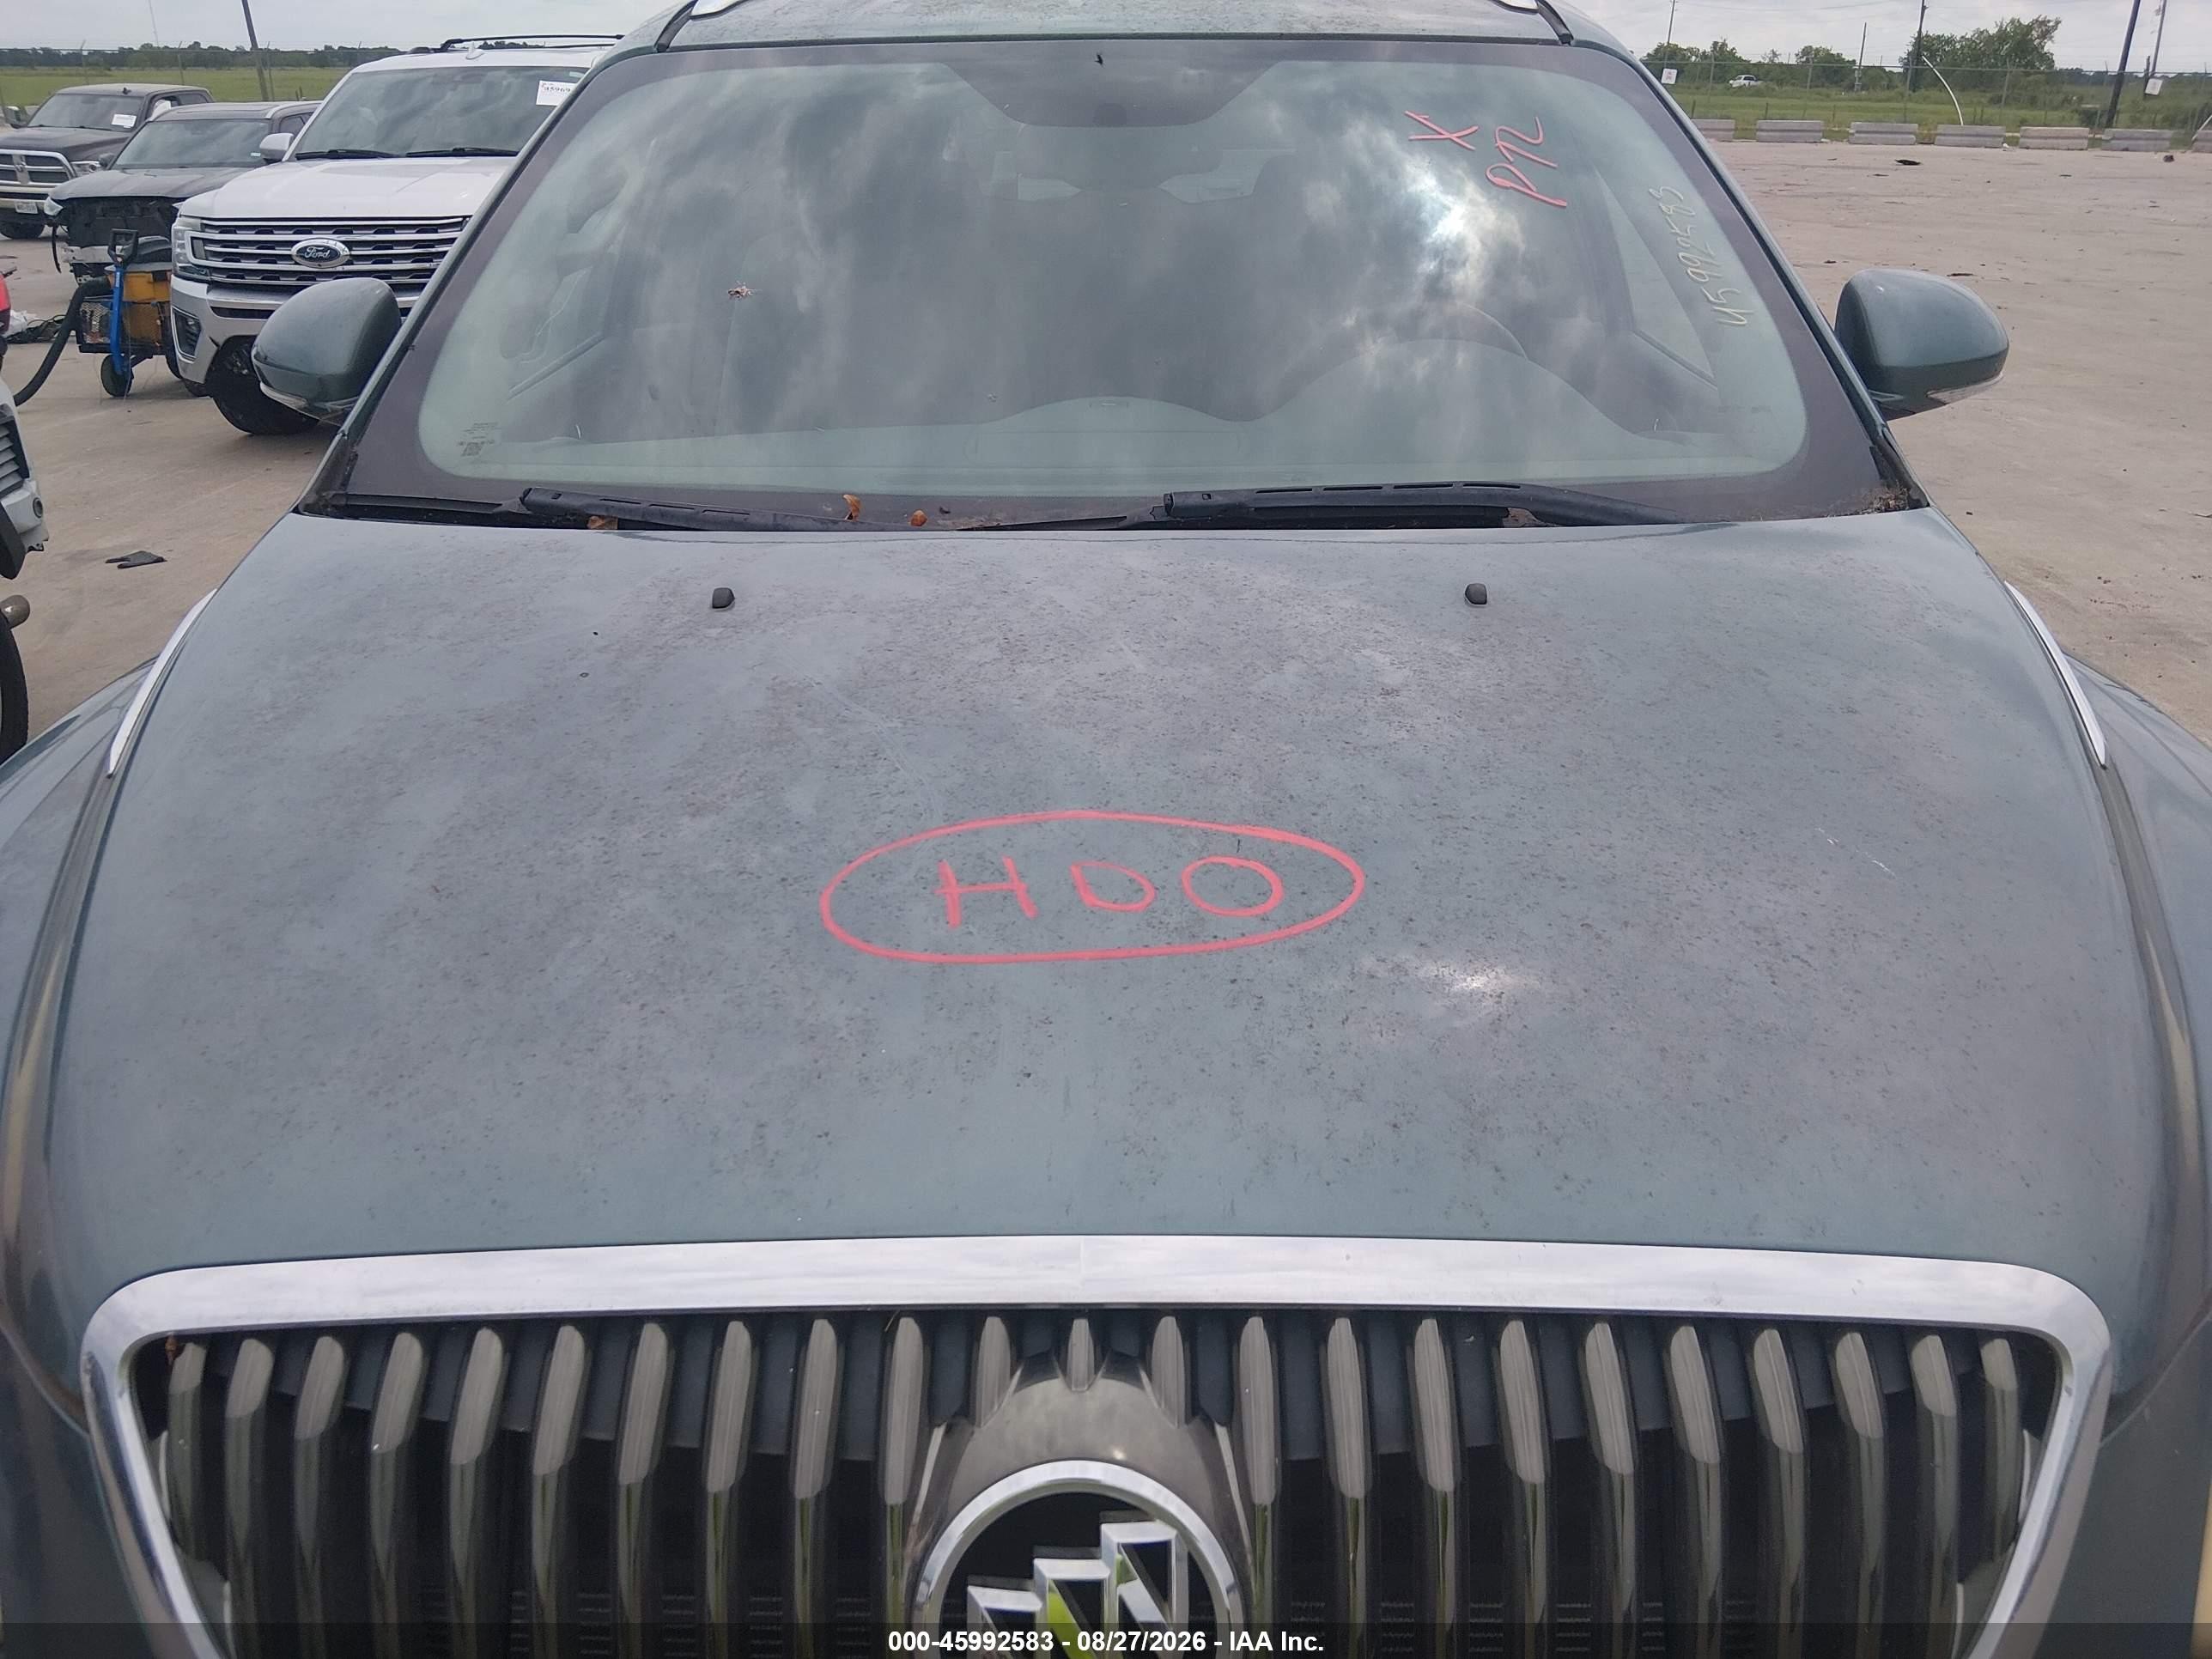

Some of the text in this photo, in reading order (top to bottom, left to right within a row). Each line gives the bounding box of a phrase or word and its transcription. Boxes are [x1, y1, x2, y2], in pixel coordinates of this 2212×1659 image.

[1403, 109, 1479, 151] X
[304, 246, 331, 258] Ford
[1648, 185, 1756, 327] 45992583
[934, 855, 1285, 928] HDO
